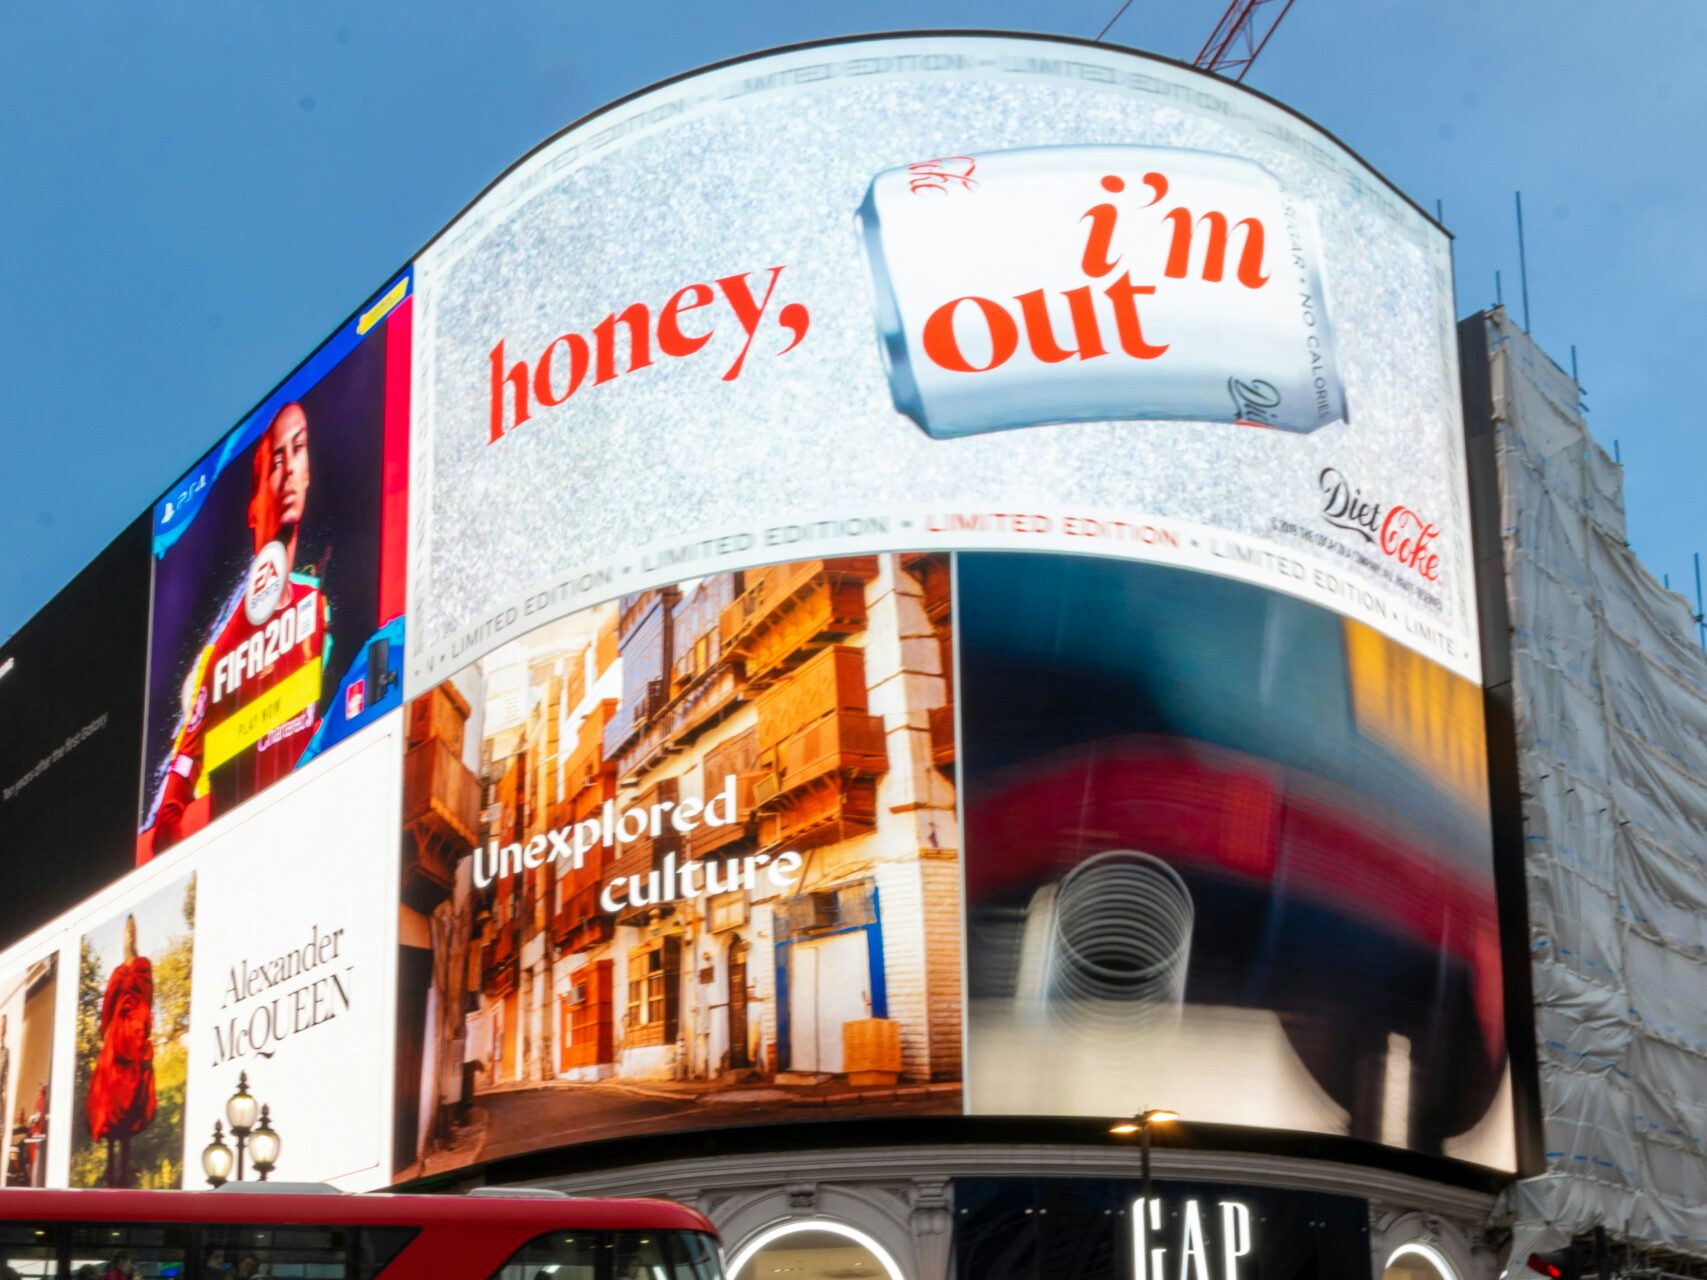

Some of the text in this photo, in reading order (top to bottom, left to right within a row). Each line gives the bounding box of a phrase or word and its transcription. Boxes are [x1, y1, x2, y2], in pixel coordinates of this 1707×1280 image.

[1080, 171, 1271, 290] i'm
[488, 265, 810, 446] honey,
[922, 270, 1171, 373] out
[1318, 466, 1441, 582] Diet Coke
[250, 580, 280, 610] SPORTS
[253, 560, 279, 594] EA
[451, 606, 518, 660] LIMITED
[523, 568, 613, 617] EDITION
[641, 532, 755, 573] LIMITED
[765, 516, 890, 548] EDITION
[925, 513, 1052, 533] LIMITED
[1062, 516, 1180, 549] EDITION
[1212, 538, 1306, 581] LIMITED
[1313, 569, 1388, 620] EDITION
[472, 773, 737, 889] Unexplored
[600, 850, 803, 913] culture
[211, 966, 355, 1068] McQUEEN
[220, 924, 345, 1010] Alexander
